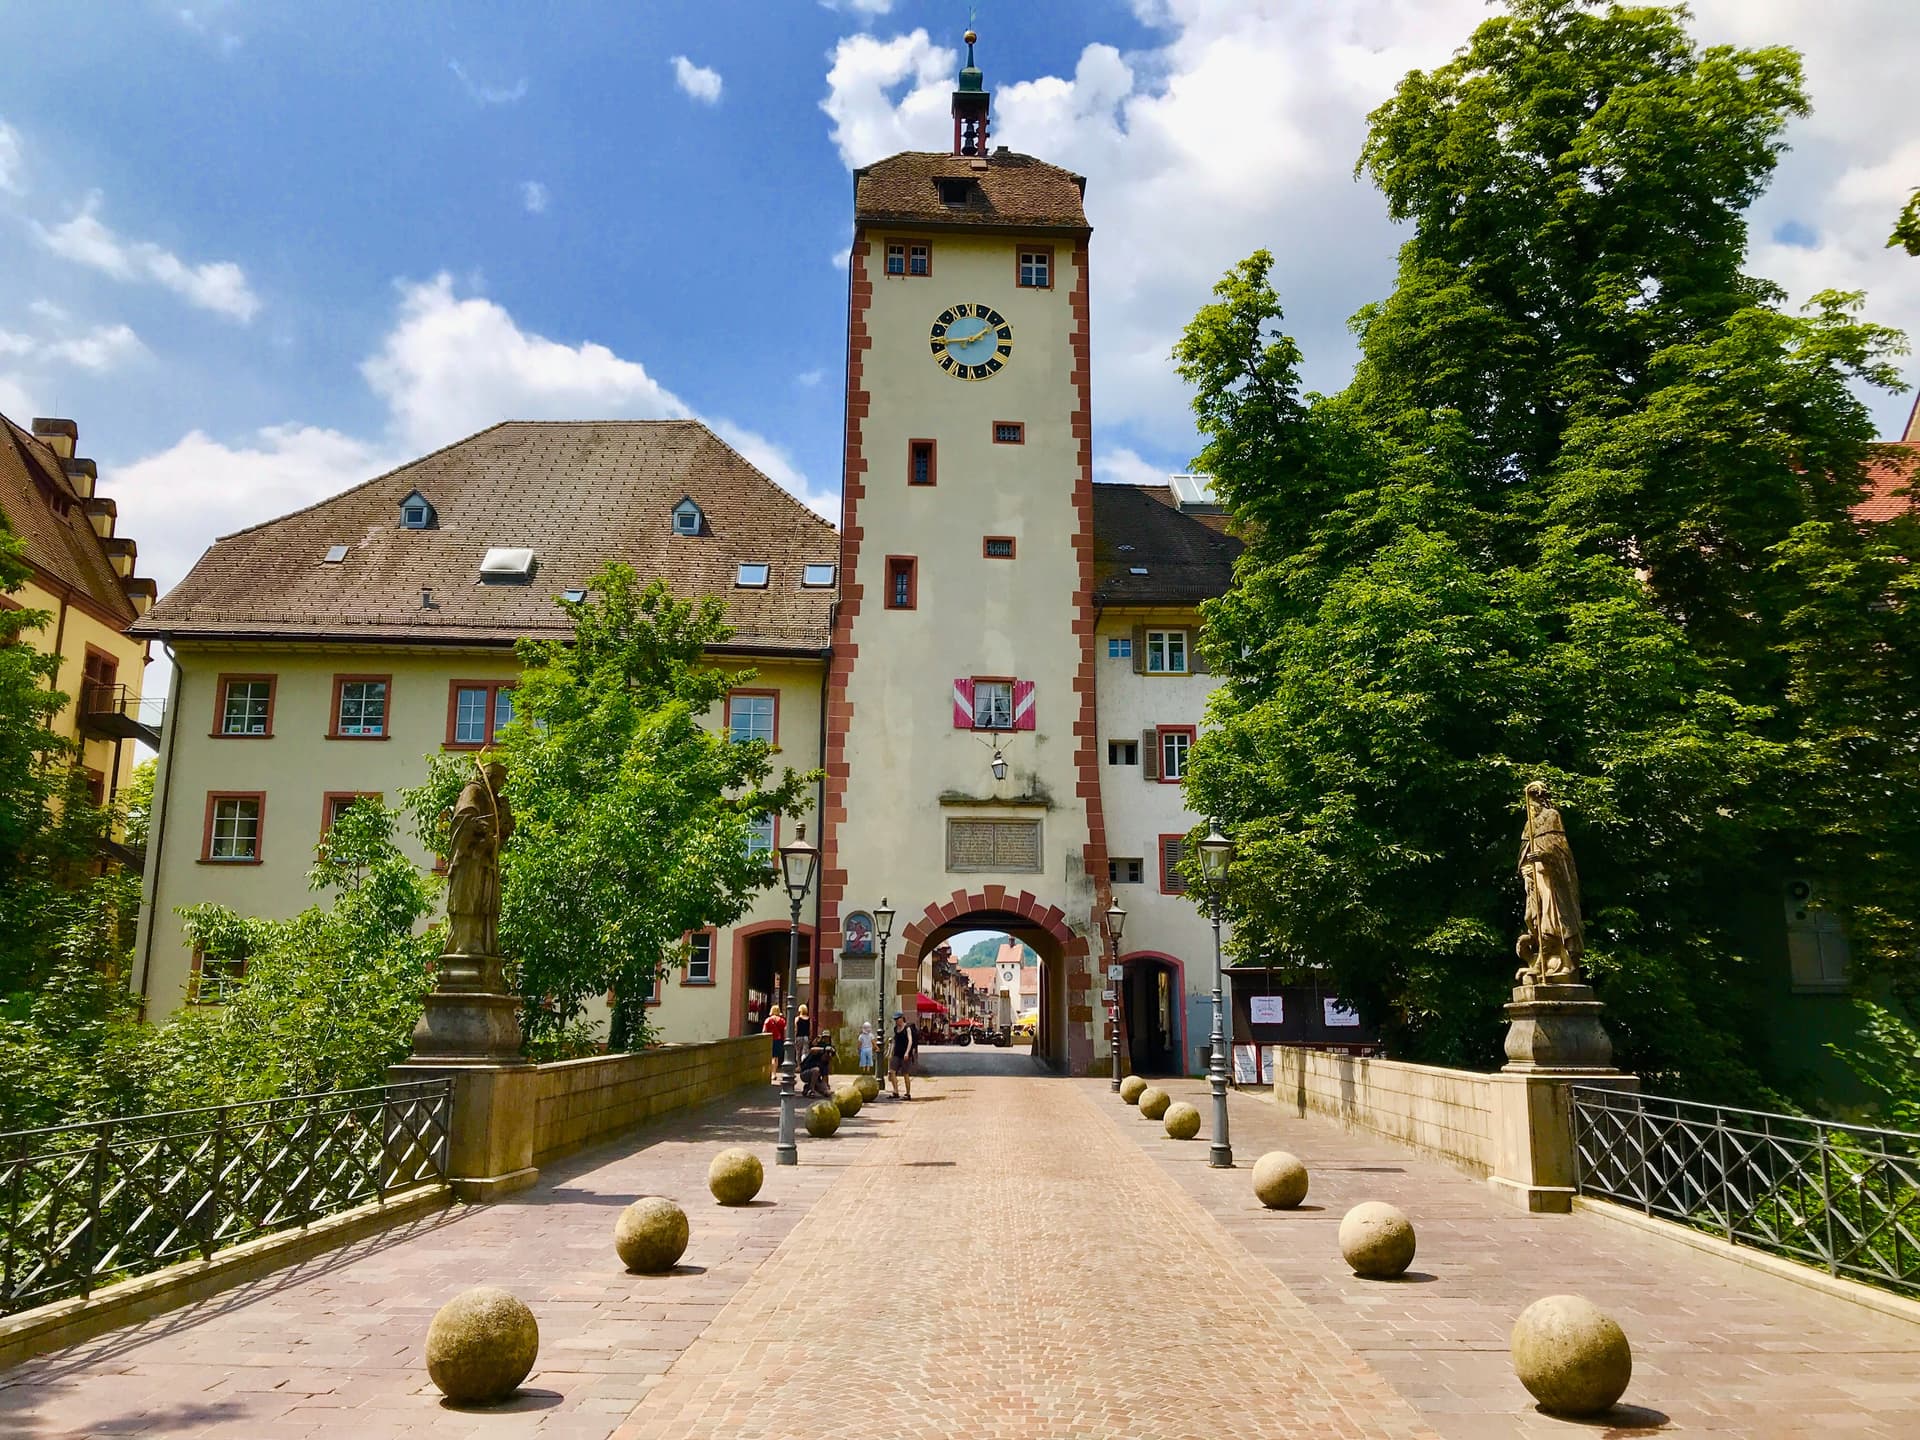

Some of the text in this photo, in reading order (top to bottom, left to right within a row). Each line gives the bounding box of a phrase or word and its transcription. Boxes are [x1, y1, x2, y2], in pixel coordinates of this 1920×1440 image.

[949, 306, 961, 320] XI
[965, 303, 976, 317] XII
[985, 308, 993, 320] I
[994, 321, 1008, 331] II
[935, 349, 948, 364] VIII
[992, 351, 1008, 364] IIII
[948, 361, 959, 376] VII
[967, 365, 976, 380] VI
[985, 364, 994, 376] V
